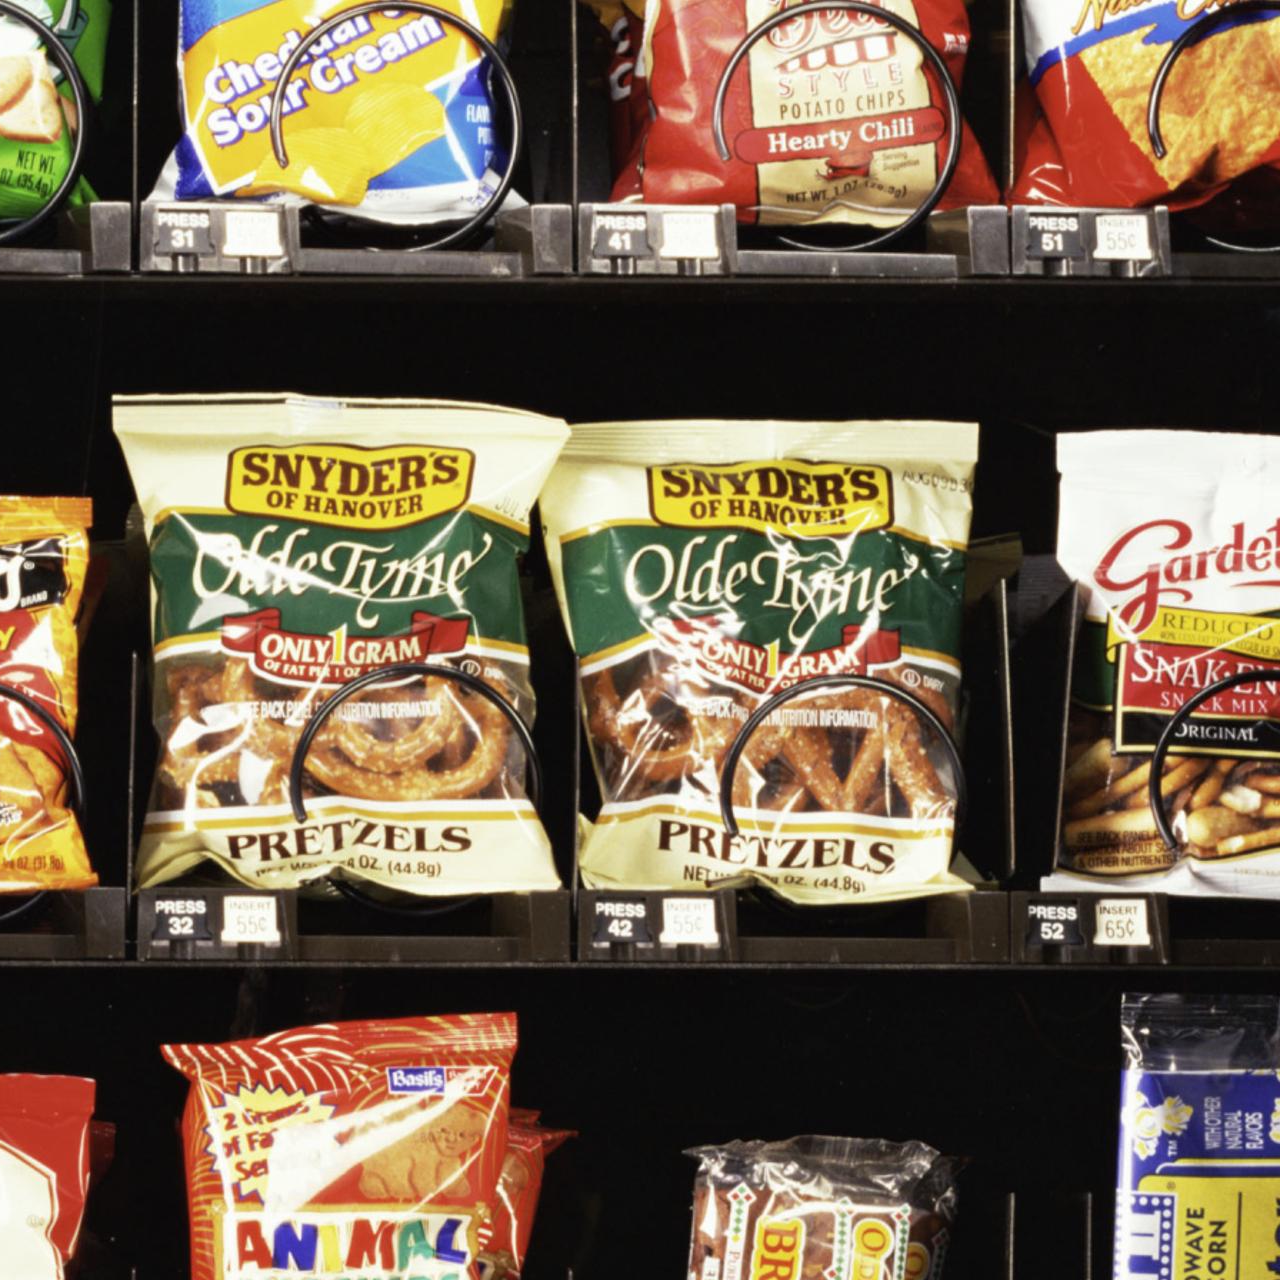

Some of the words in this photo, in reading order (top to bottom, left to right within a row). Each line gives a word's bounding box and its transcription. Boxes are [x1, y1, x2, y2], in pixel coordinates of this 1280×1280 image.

[309, 16, 445, 94] Cream
[777, 64, 904, 98] STYLE
[780, 97, 845, 120] POTATO
[856, 90, 906, 111] CHIPS
[768, 127, 852, 153] Hearty
[858, 118, 915, 142] Chili
[241, 452, 459, 497] SNYDER'S
[266, 491, 297, 509] OF
[303, 495, 423, 518] HANOVER
[192, 526, 321, 600] Olde
[321, 534, 492, 627] Tyme
[1161, 612, 1258, 640] REDUCED
[261, 635, 330, 663] ONLY
[349, 638, 422, 664] GRAM
[1231, 698, 1268, 712] MIX
[227, 821, 472, 862] PRETZELS
[1100, 906, 1138, 915] INSERT
[1105, 920, 1135, 939] 65¢
[393, 1069, 443, 1091] Basil's
[236, 1218, 468, 1270] ANIMAL
